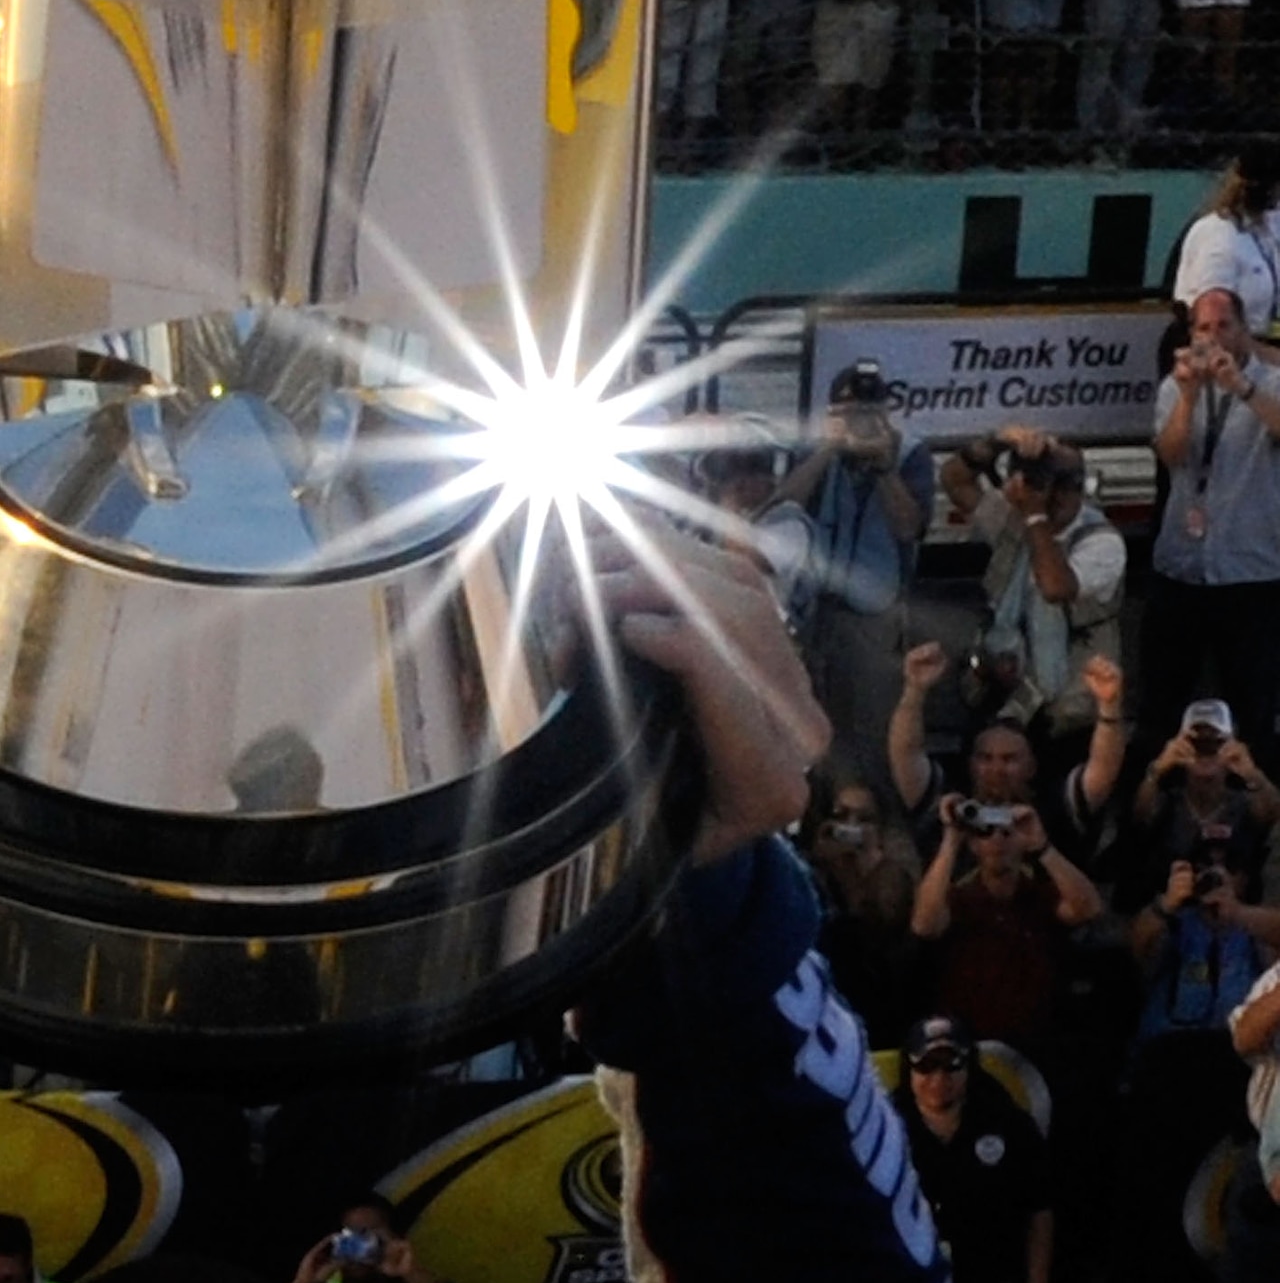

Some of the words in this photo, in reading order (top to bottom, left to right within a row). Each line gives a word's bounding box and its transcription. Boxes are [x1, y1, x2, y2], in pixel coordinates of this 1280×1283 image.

[949, 339, 1055, 371] Thank
[1066, 337, 1129, 368] You
[886, 378, 987, 417] Sprint
